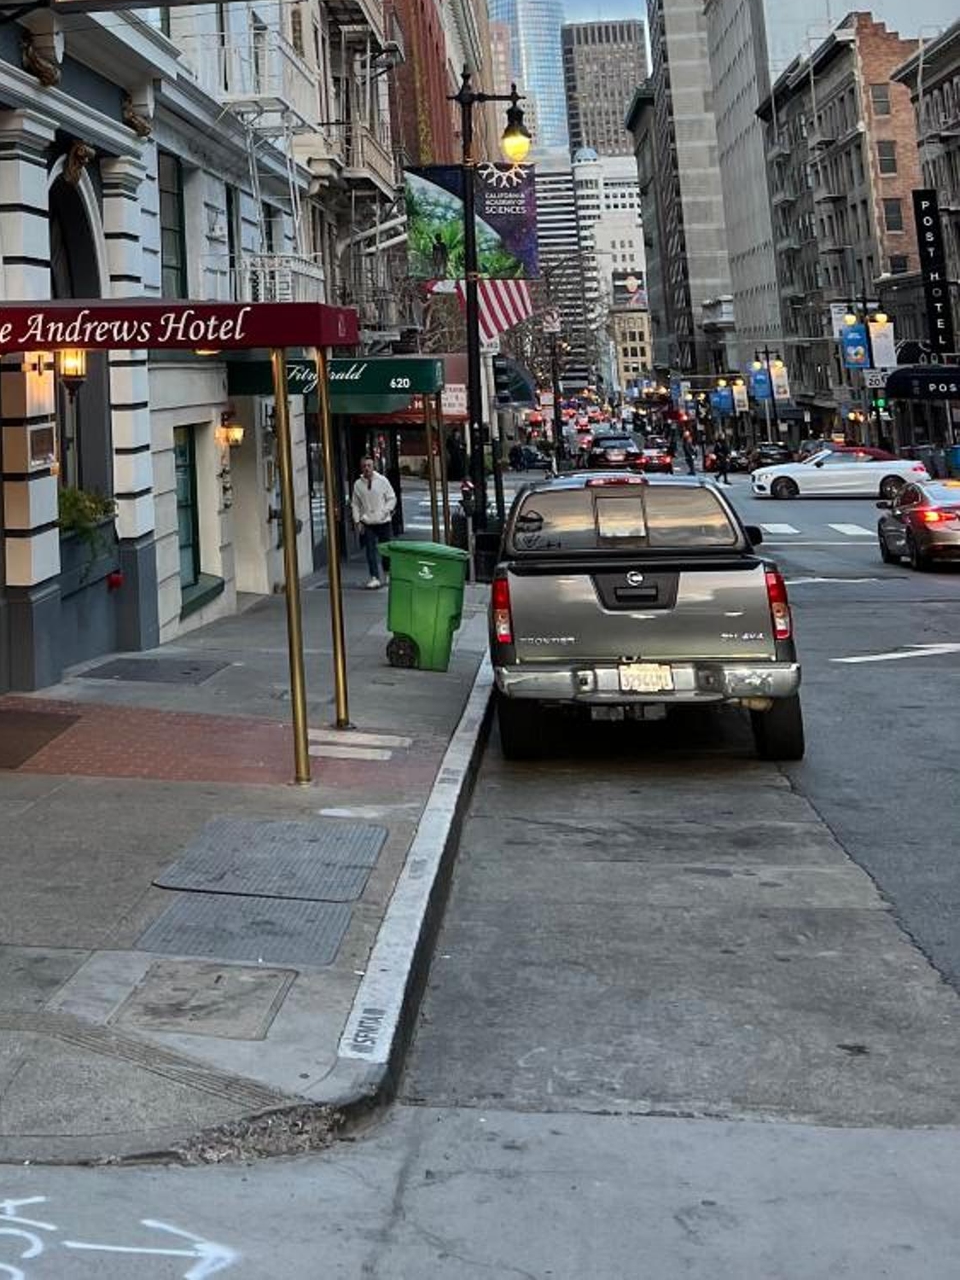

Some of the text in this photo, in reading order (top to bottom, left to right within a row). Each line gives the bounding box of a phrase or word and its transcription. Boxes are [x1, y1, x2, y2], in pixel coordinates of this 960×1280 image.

[485, 206, 527, 214] SCIENCES
[921, 200, 947, 345] POST HOTEL
[17, 310, 151, 344] Andrews
[157, 306, 251, 342] Hotel
[285, 362, 368, 394] Fitzgrald
[390, 377, 411, 389] 620
